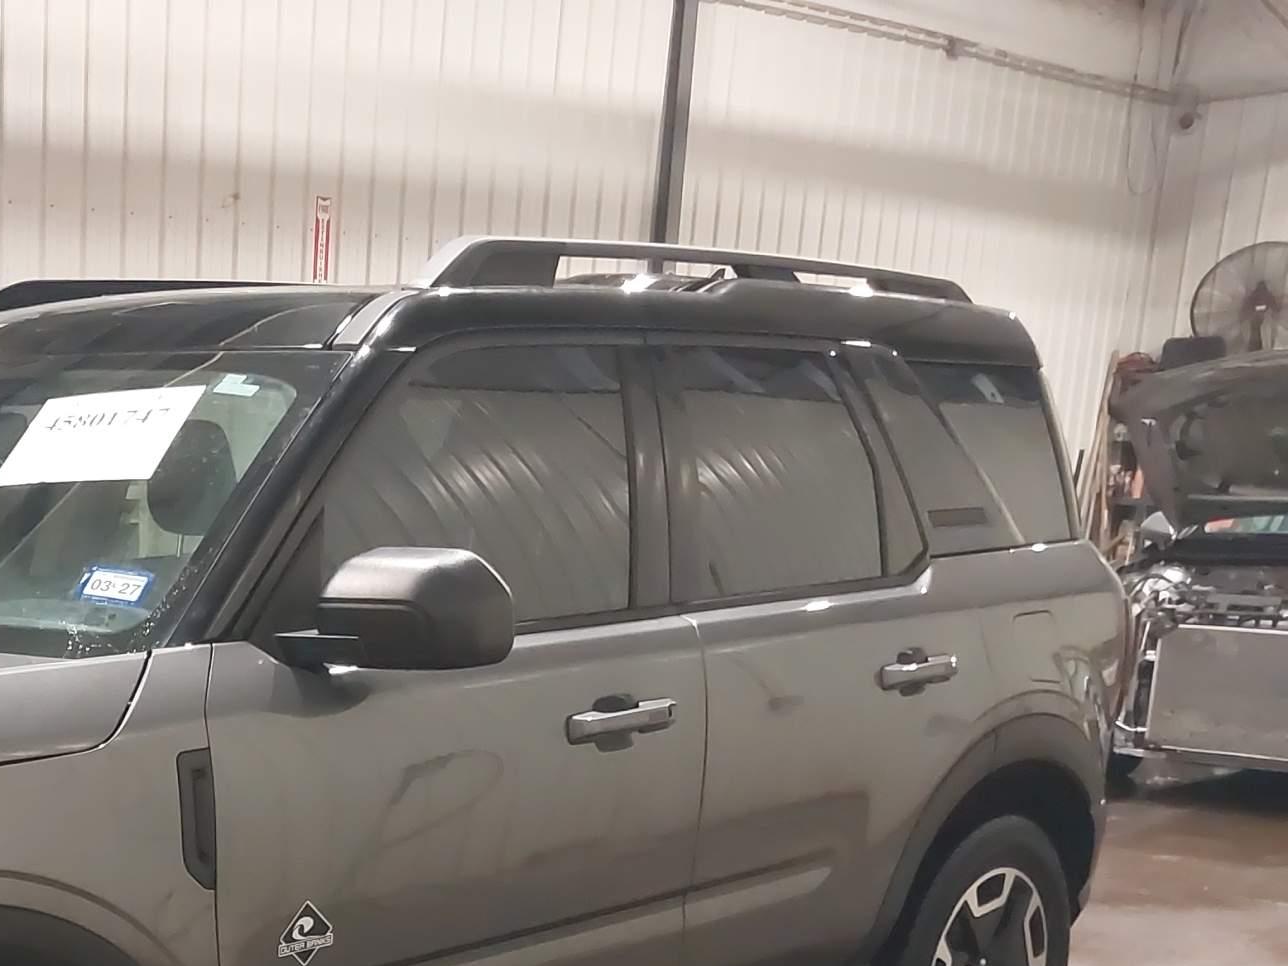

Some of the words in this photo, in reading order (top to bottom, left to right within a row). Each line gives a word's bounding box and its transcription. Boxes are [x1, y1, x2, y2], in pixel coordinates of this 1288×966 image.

[90, 578, 112, 592] 03
[118, 582, 142, 596] 27
[281, 942, 306, 955] OUTER
[307, 936, 331, 949] BANKS
